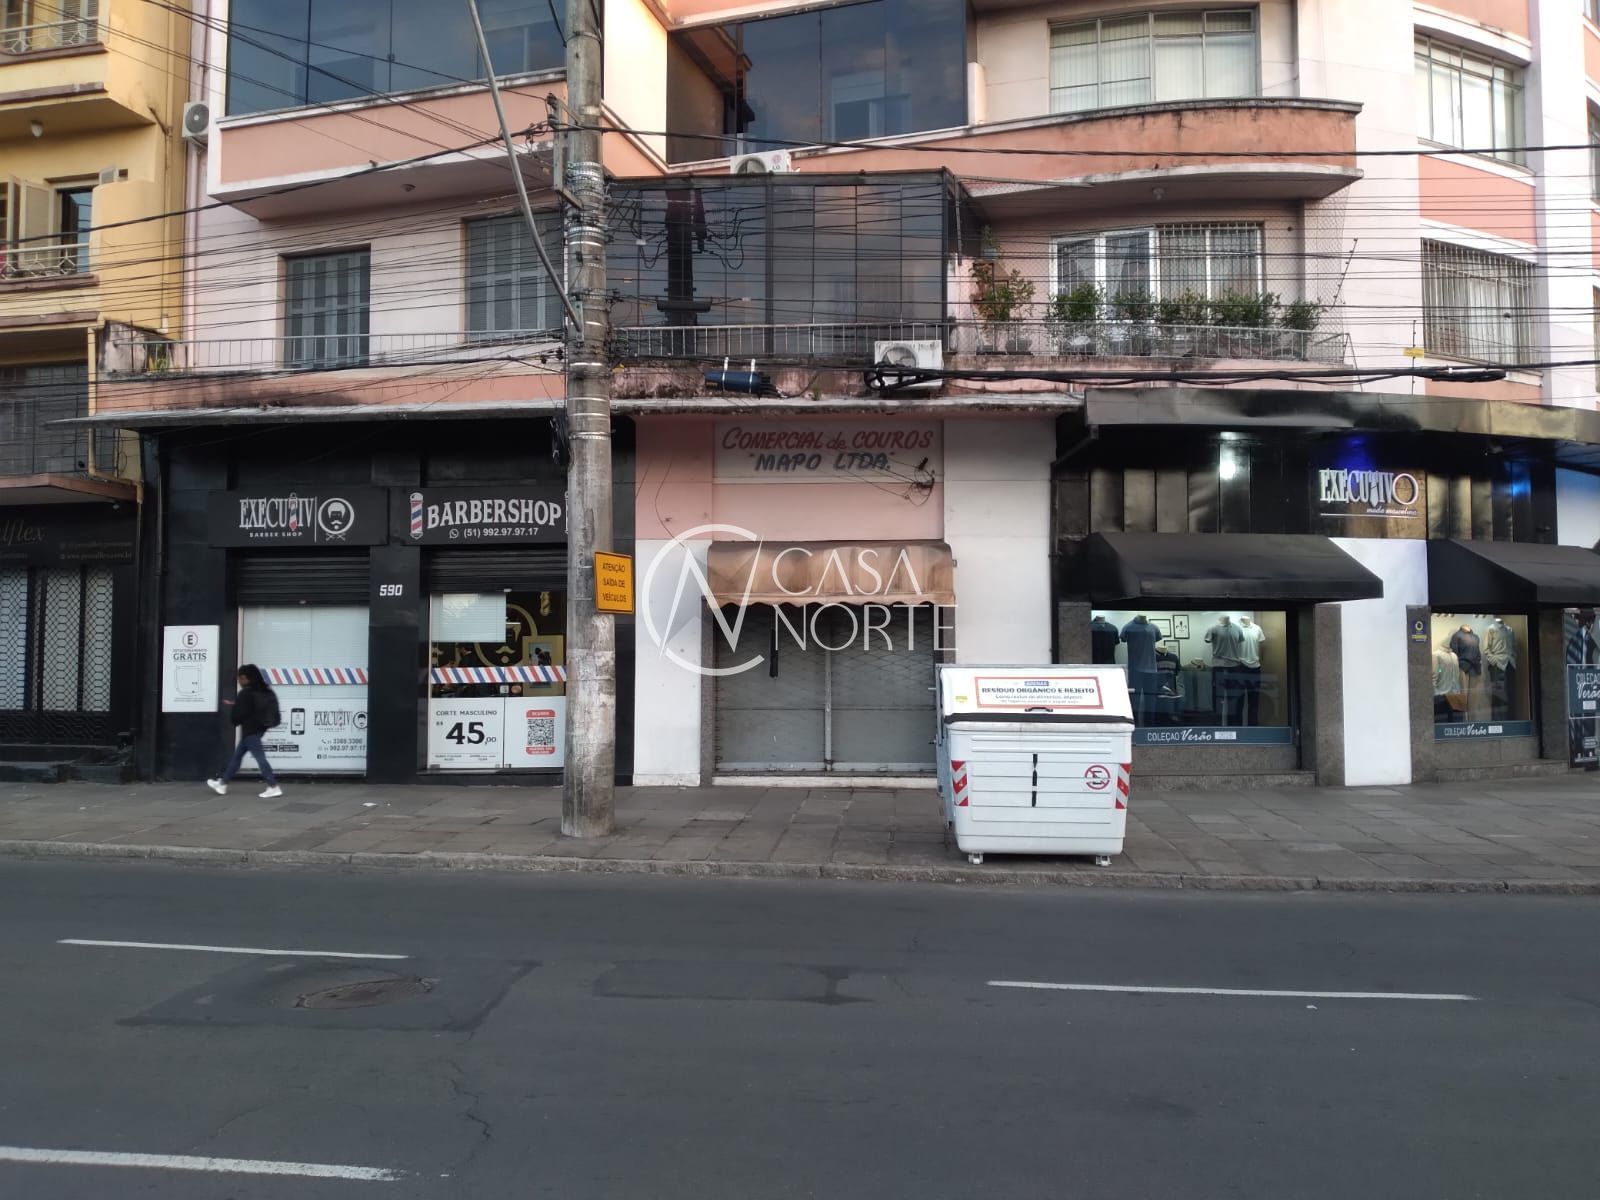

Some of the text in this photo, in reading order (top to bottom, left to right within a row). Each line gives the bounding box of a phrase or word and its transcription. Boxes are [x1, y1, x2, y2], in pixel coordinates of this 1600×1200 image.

[722, 427, 934, 450] COMERCIAL de COUROS
[427, 500, 562, 529] BARBERSHOP
[463, 527, 539, 539] (51) 992.97.97.17
[602, 562, 626, 573] ATENÇÃO
[379, 584, 403, 597] 590
[1016, 686, 1056, 694] ORGÂNICO
[1180, 729, 1212, 741] Verão
